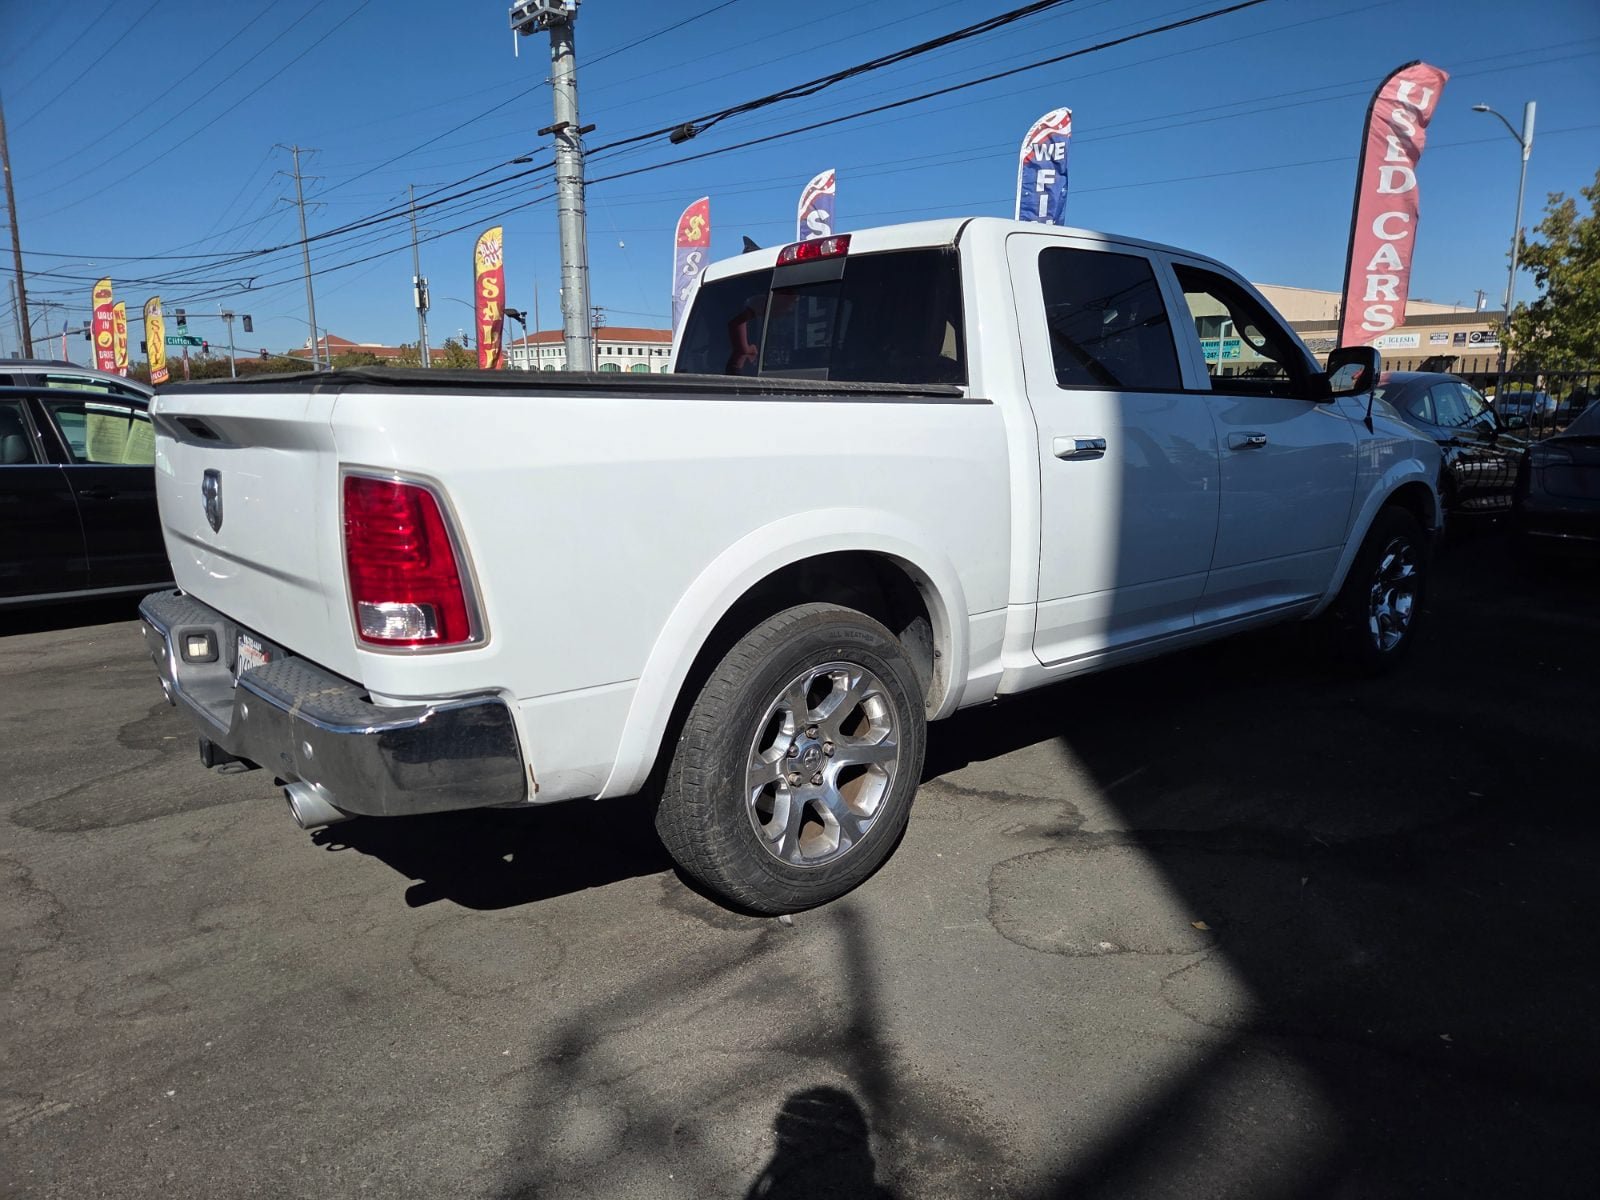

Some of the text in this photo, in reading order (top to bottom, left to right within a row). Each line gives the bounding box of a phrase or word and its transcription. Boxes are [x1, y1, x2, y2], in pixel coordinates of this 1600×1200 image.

[1377, 79, 1434, 194] USED
[1033, 142, 1066, 161] WE
[480, 239, 499, 257] BLOW
[1361, 211, 1410, 332] CARS
[102, 321, 110, 330] IN
[105, 361, 115, 370] OU
